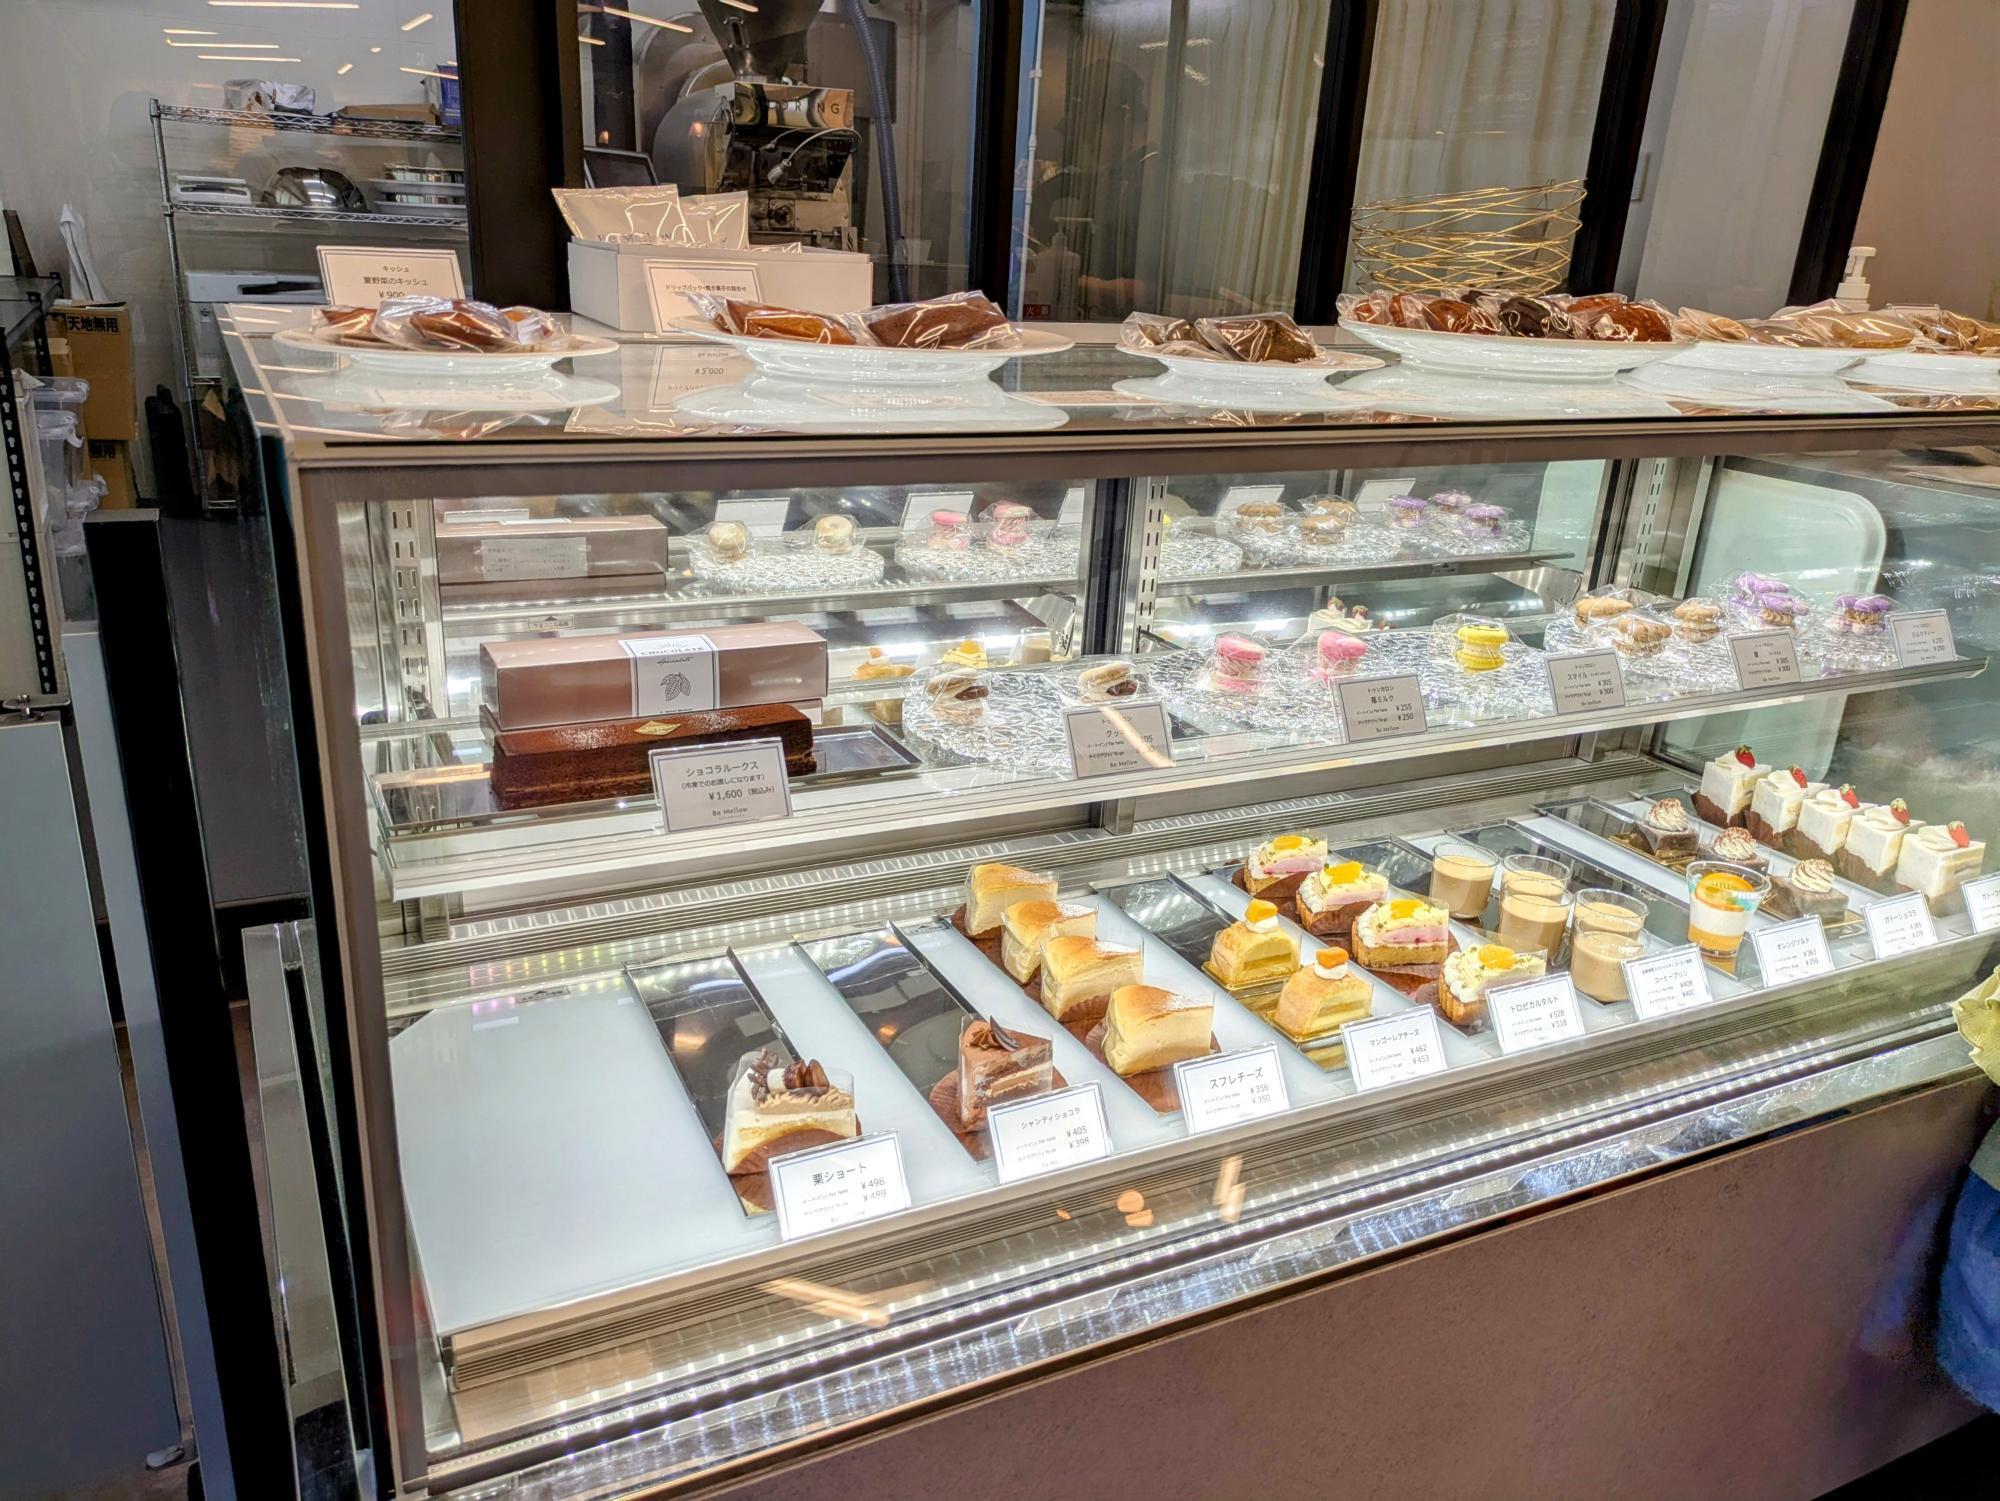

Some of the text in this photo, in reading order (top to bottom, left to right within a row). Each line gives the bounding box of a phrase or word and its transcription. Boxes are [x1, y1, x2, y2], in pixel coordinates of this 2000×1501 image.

[382, 265, 409, 273] キッシュ
[67, 316, 118, 333] 天地無用
[641, 646, 705, 656] CHOCOLATE
[1567, 671, 1587, 681] スマイル
[686, 761, 760, 777] ショコラルークス
[708, 788, 743, 801] ¥1,600
[1510, 993, 1559, 1014] トロピカルタルト
[1368, 1027, 1421, 1047] マンゴーレアチーズ
[1412, 1053, 1430, 1065] ¥453
[1208, 1066, 1264, 1090] スフレチーズ
[1019, 1105, 1081, 1130] シャンティショコラ
[1064, 1124, 1088, 1139] ¥405
[1067, 1135, 1090, 1150] ¥398
[811, 1160, 868, 1186] 栗ショート
